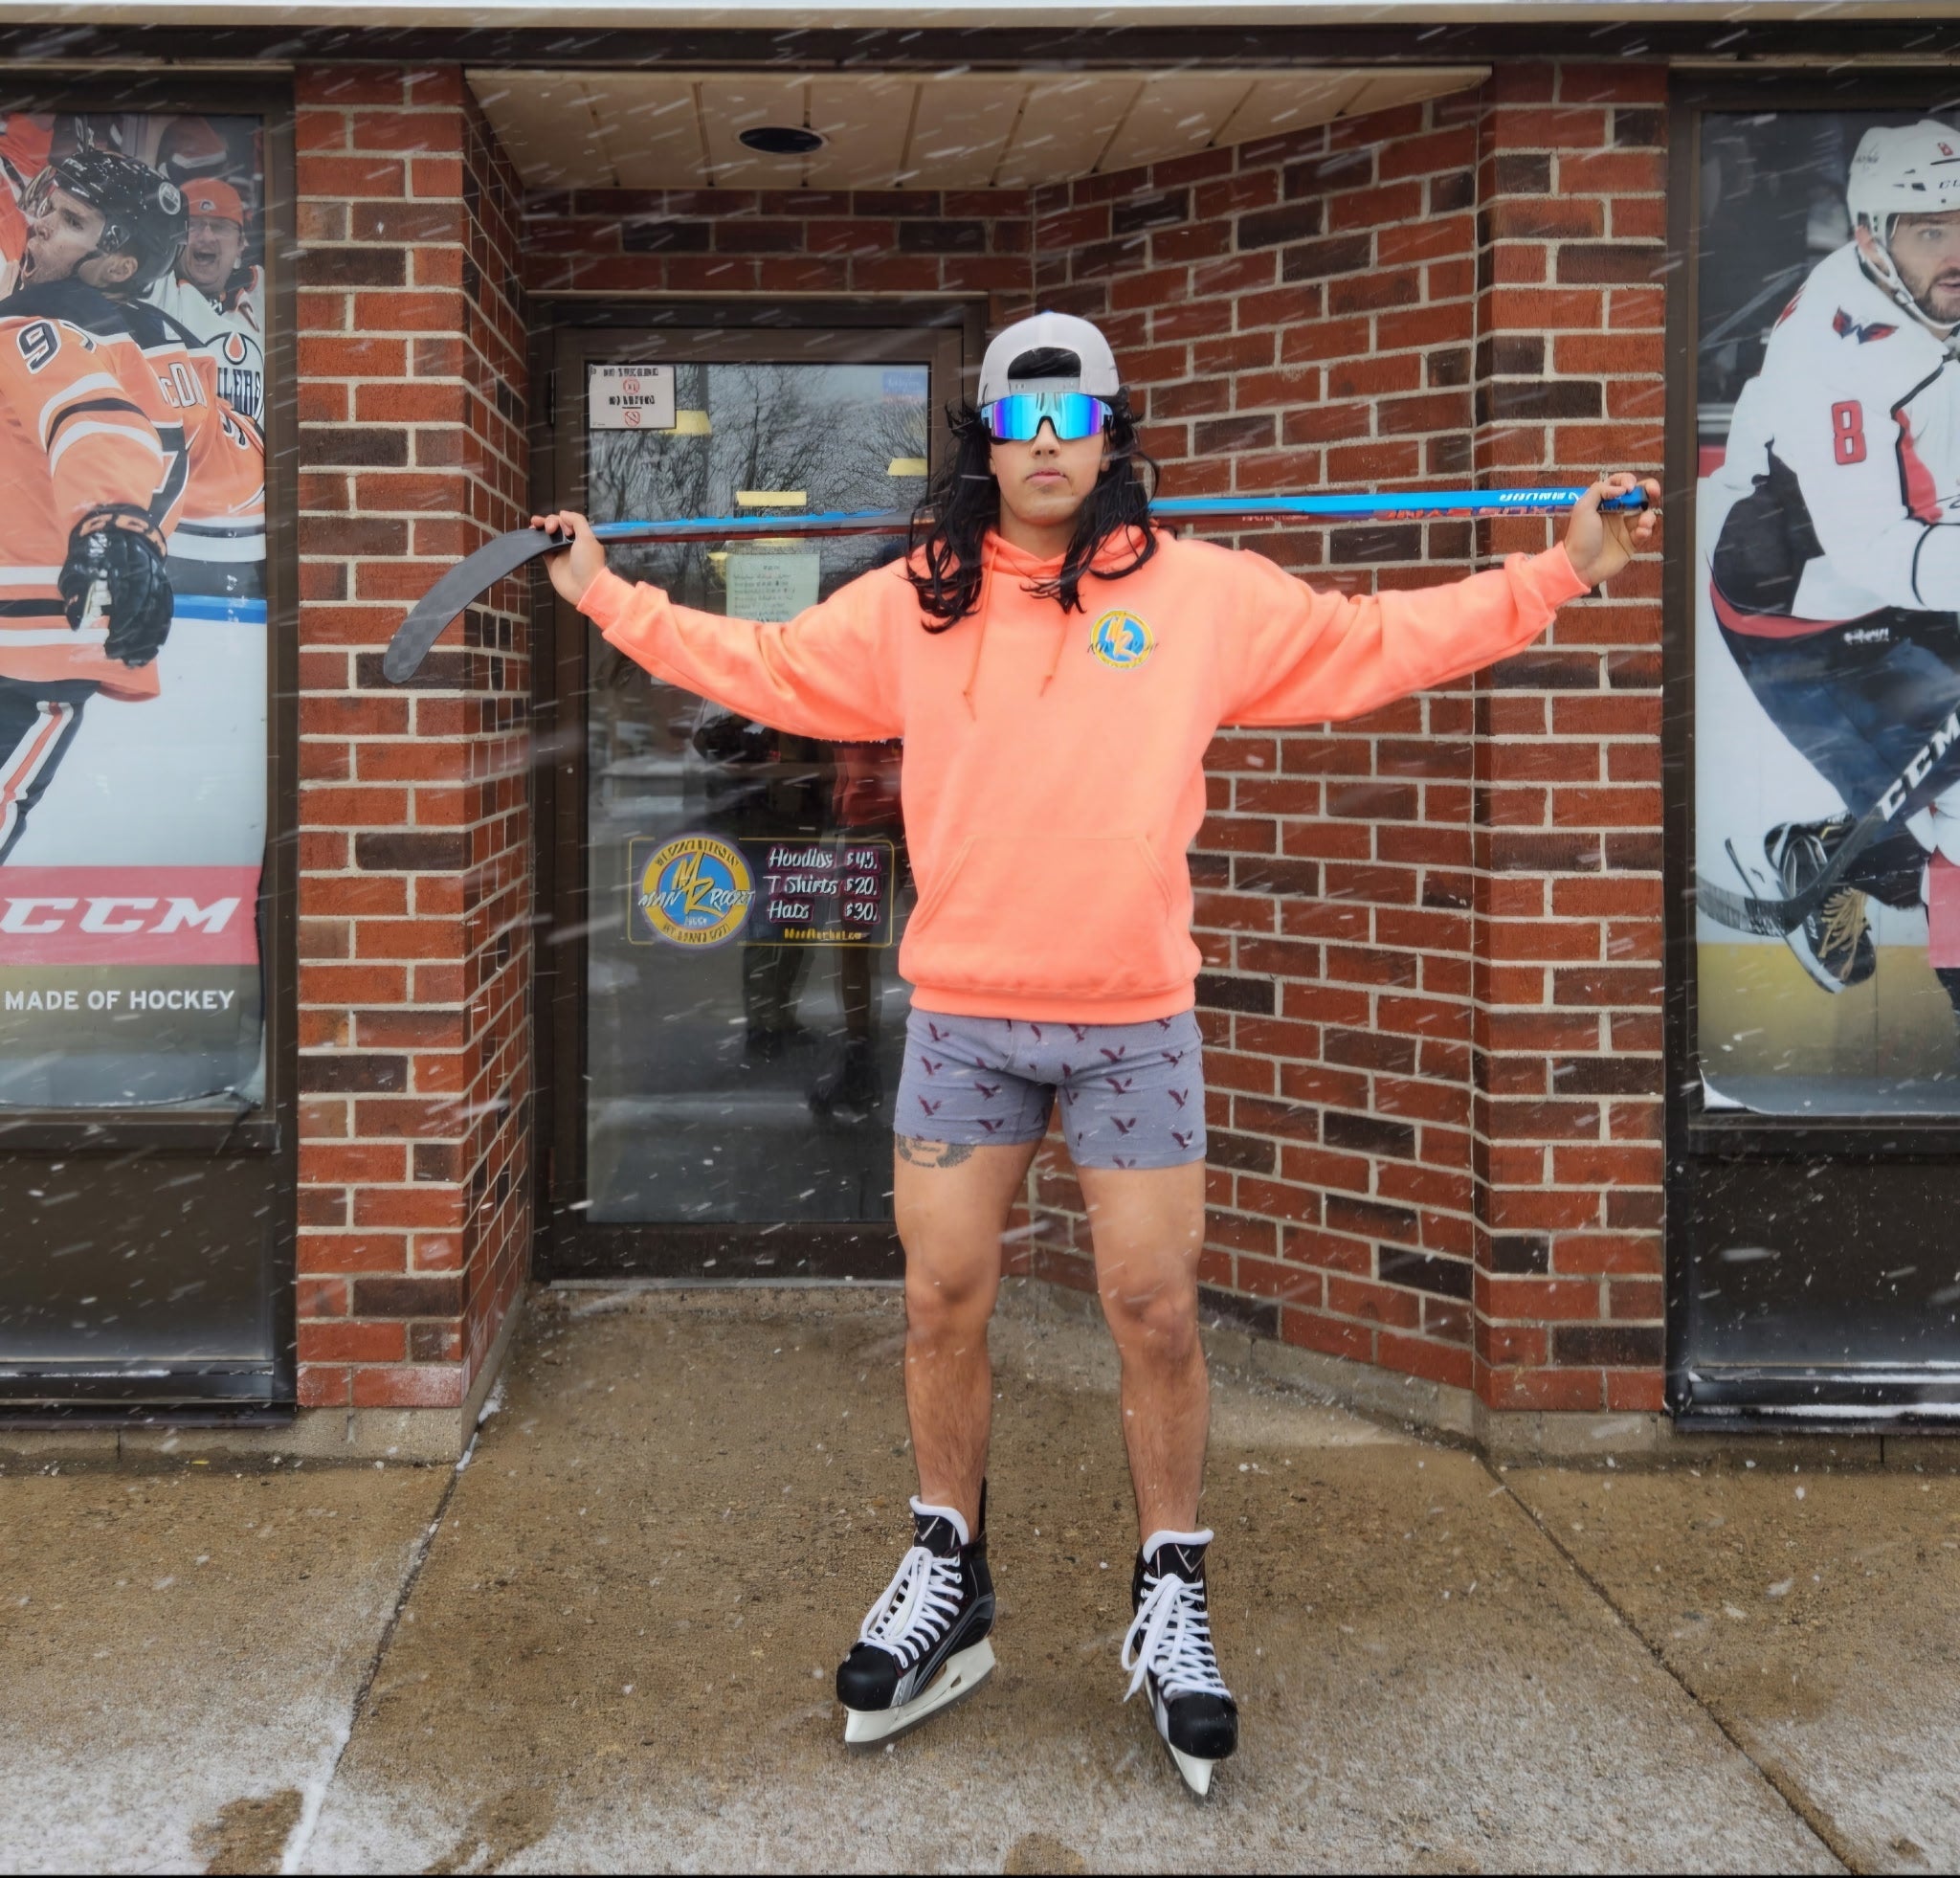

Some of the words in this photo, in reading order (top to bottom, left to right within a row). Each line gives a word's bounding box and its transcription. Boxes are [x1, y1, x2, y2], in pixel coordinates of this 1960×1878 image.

[1831, 399, 1867, 465] 8
[763, 875, 781, 894] T
[784, 874, 838, 895] Shirts
[0, 897, 241, 934] CCM
[5, 990, 79, 1011] MADE
[87, 990, 122, 1011] OF
[129, 990, 235, 1011] HOCKEY
